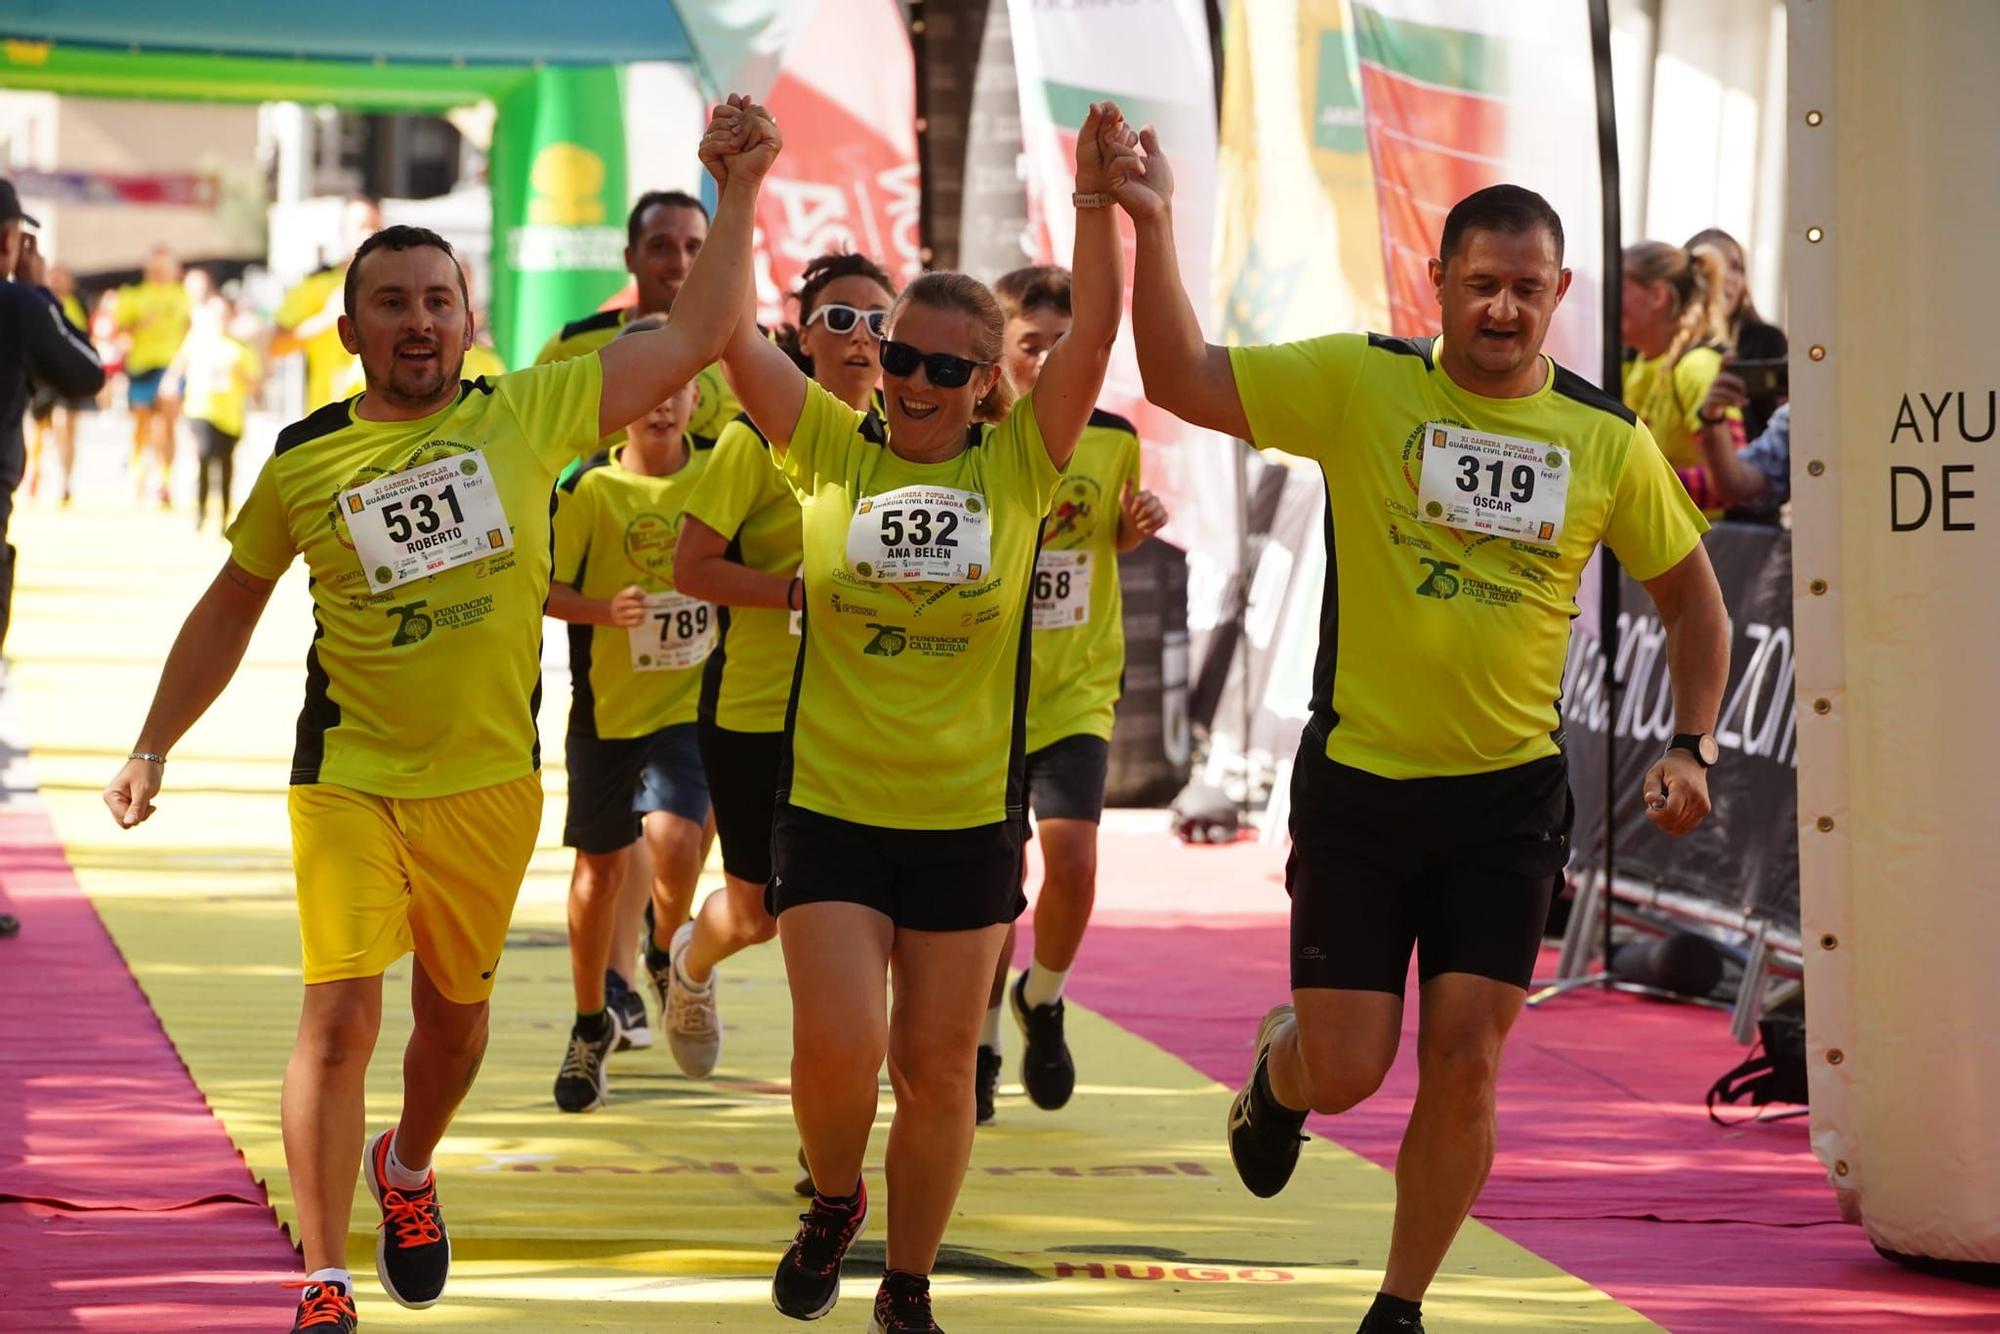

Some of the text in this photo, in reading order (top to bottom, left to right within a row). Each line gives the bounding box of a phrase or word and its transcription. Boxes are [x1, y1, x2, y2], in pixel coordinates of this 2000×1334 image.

[1448, 440, 1481, 452] GUARDIA
[1483, 446, 1501, 456] CIVIL
[1514, 452, 1543, 463] ZAMORA
[1471, 437, 1501, 449] CARRERA
[1505, 443, 1535, 454] POPULAR
[366, 471, 460, 506] GUARDIA CIVIL DE ZAMORA
[384, 477, 415, 492] CARRERA
[417, 466, 448, 480] POPULAR
[1456, 455, 1535, 503] 319
[925, 492, 955, 500] POPULAR
[935, 499, 964, 509] ZAMORA
[1473, 494, 1512, 513] ÓSCAR
[1890, 465, 1976, 531] DE
[382, 484, 464, 543] 531
[406, 527, 462, 554] ROBERTO
[881, 509, 959, 547] 532
[887, 548, 910, 559] ANA
[1416, 557, 1460, 600] 25
[1463, 586, 1519, 603] CAJA RURAL
[386, 599, 433, 647] 25
[436, 604, 495, 627] CAJA RURAL
[654, 605, 708, 642] 789
[863, 623, 906, 656] 25
[909, 642, 965, 652] CAJA RURAL
[1053, 1262, 1295, 1282] HUGO
